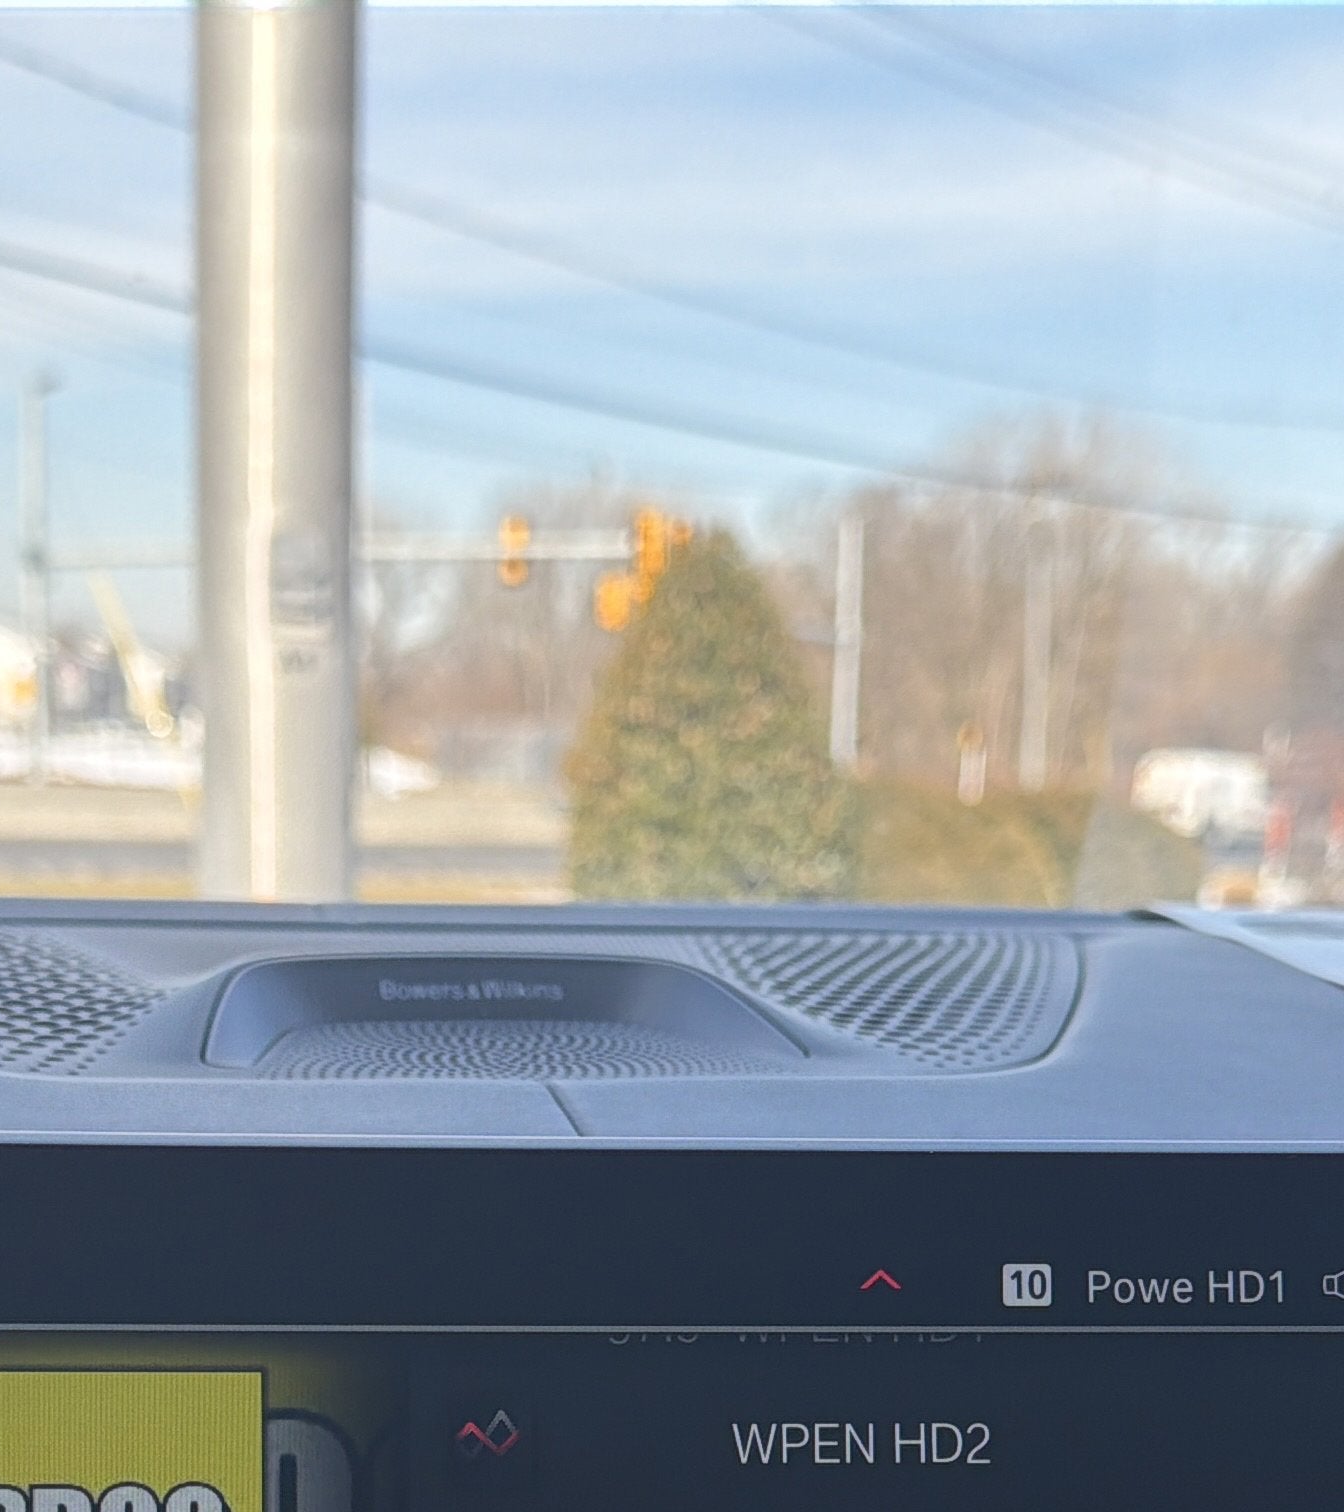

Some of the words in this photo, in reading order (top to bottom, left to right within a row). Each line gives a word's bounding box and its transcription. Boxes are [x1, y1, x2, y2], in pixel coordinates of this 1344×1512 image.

[1011, 1270, 1046, 1299] 10
[1089, 1271, 1193, 1303] Powe
[1209, 1271, 1282, 1302] HD1
[732, 1423, 873, 1463] WPEN
[895, 1423, 990, 1463] HD2
